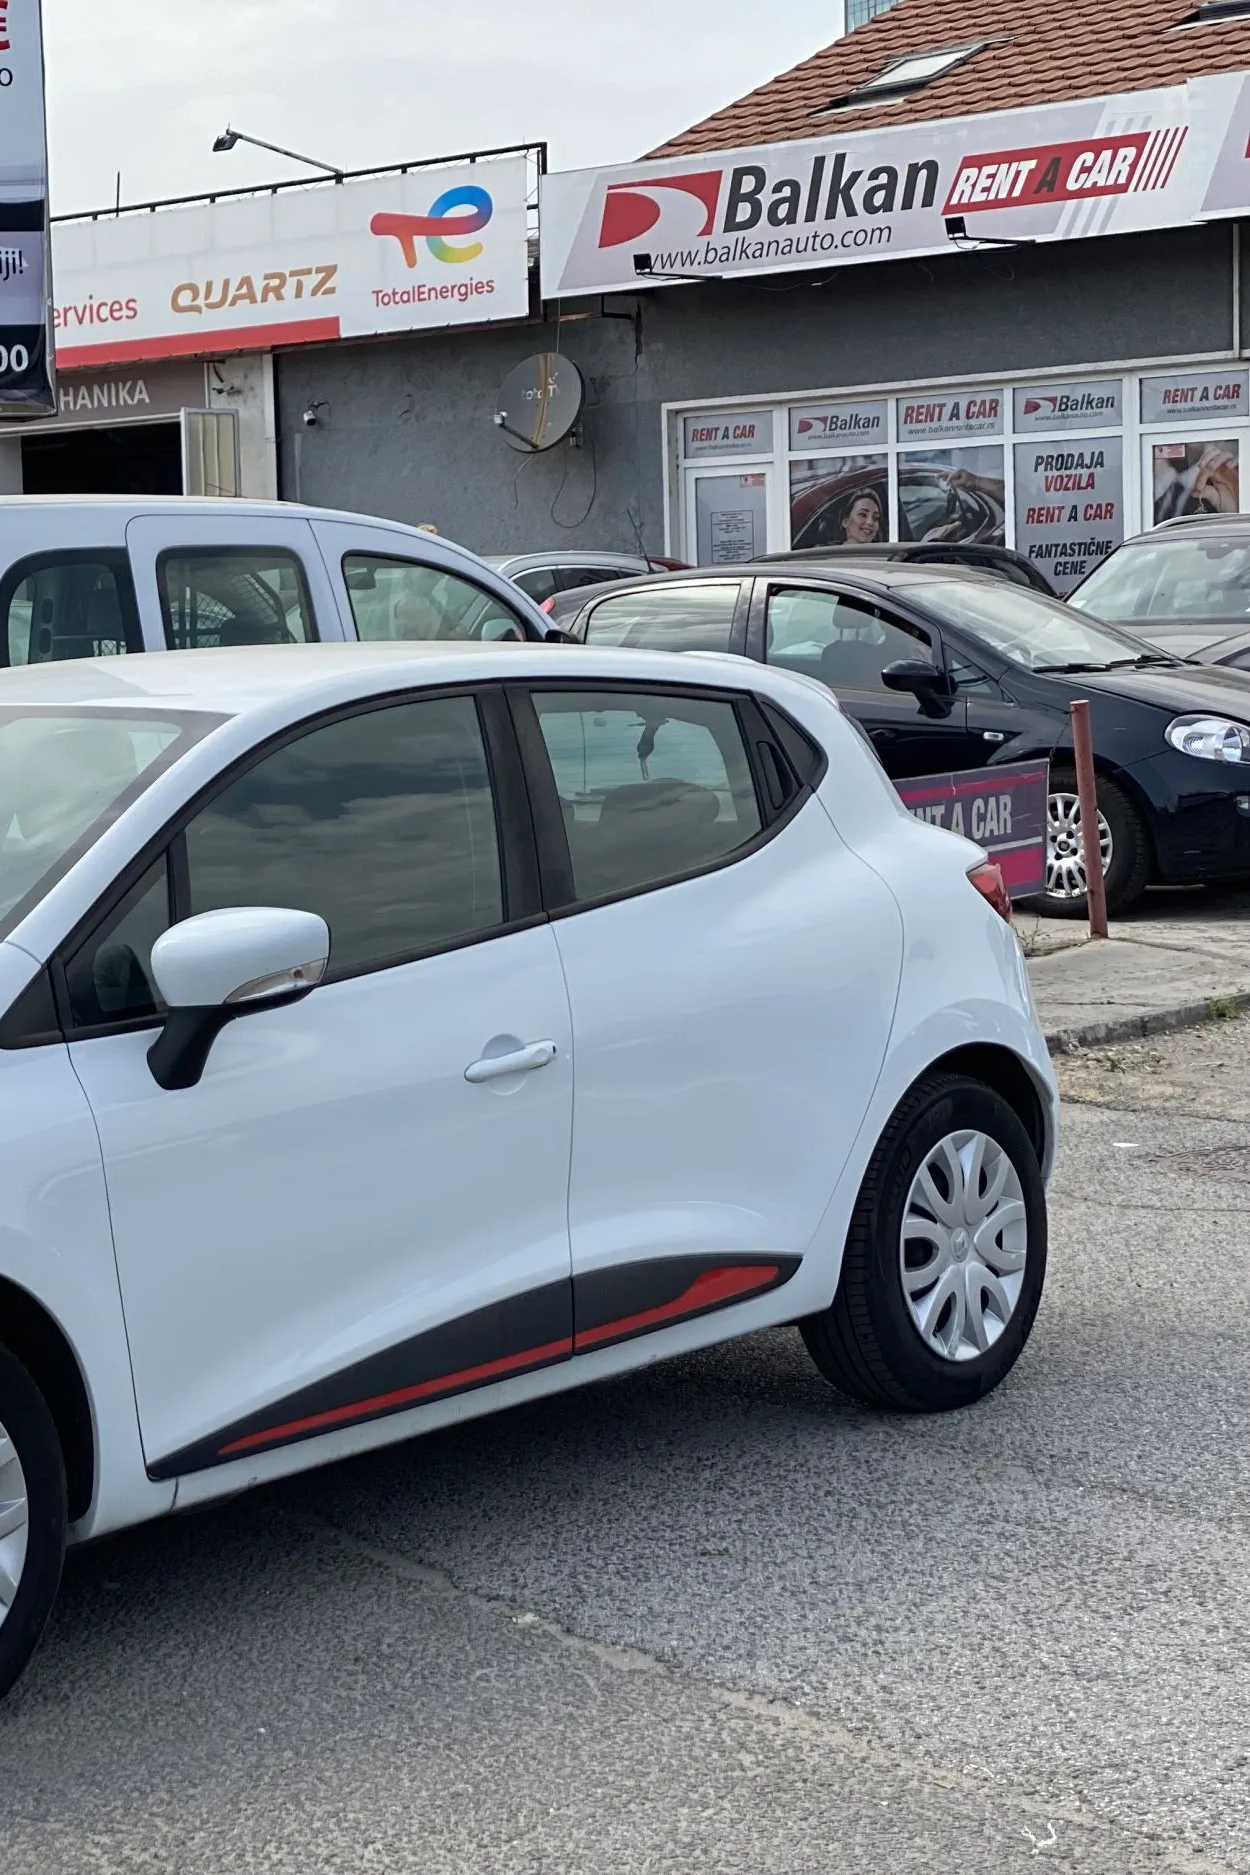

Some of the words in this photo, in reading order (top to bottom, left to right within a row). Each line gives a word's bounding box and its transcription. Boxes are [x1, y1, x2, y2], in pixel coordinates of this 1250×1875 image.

[952, 160, 1036, 205] RENT
[1037, 157, 1062, 193] A
[1065, 145, 1136, 190] CAR
[722, 152, 939, 234] Balkan
[651, 224, 892, 271] ww.balkanauto.com
[171, 263, 338, 314] QUARTZ
[372, 276, 495, 308] TotalEnergies
[59, 379, 150, 411] HANIKA
[1058, 394, 1115, 413] Balkan
[1162, 387, 1197, 404] RENT
[1199, 386, 1209, 401] A
[1213, 384, 1241, 400] CAR
[829, 413, 880, 431] Balkan
[904, 402, 946, 425] RENT
[948, 401, 961, 421] A
[966, 399, 999, 419] CAR
[691, 427, 720, 442] RENT
[721, 426, 730, 440] A
[733, 424, 756, 439] CAR
[1034, 451, 1104, 472] PRODAJA
[1045, 472, 1095, 492] VOZILA
[1026, 506, 1065, 524] RENT
[1067, 505, 1078, 522] A
[1083, 503, 1115, 521] CAR
[1028, 537, 1113, 558] FANTASTIČNE
[1054, 560, 1087, 576] CENE
[951, 802, 964, 837] A
[971, 795, 1012, 840] CAR
